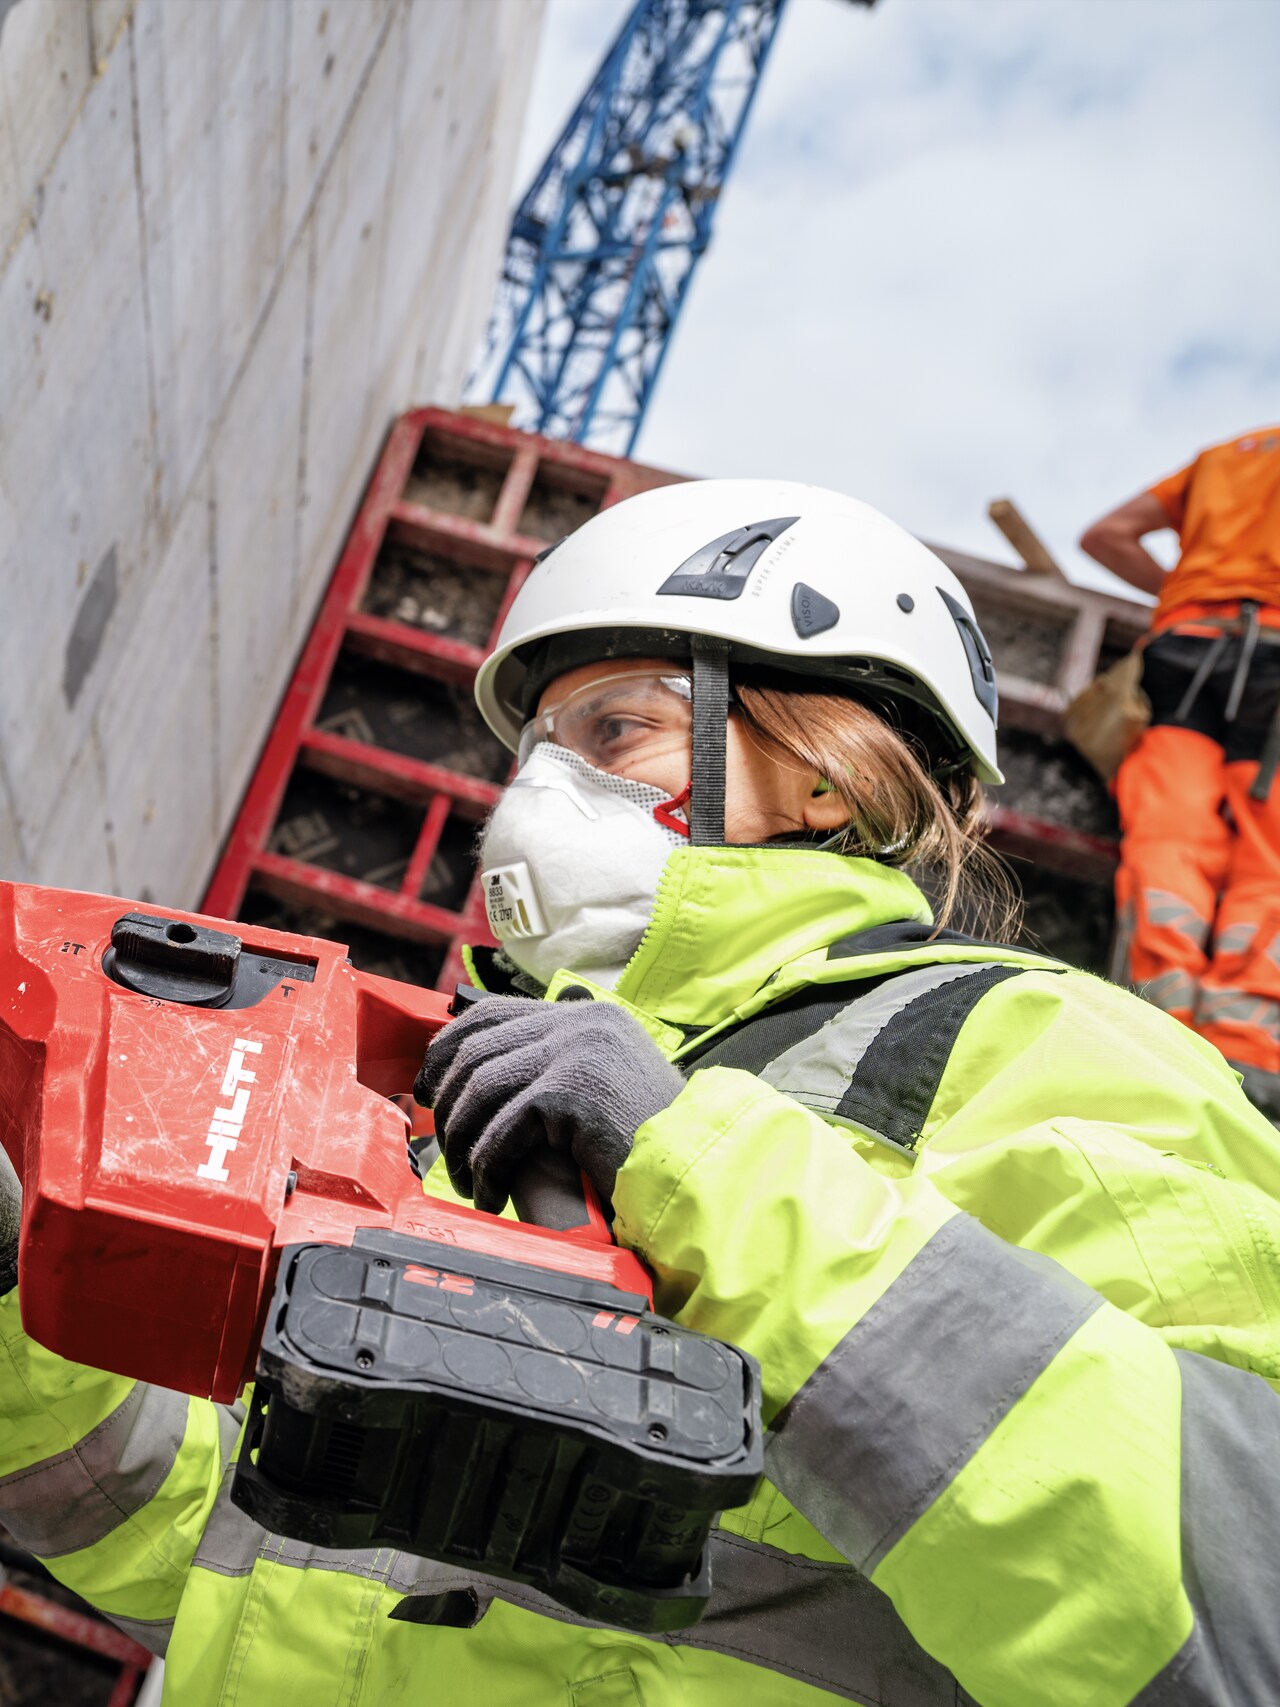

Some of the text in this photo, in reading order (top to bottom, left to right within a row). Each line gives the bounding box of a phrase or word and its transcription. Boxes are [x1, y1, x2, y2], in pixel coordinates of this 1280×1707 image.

[751, 536, 795, 597] SUPER PLASMA
[491, 875, 500, 886] 3M
[489, 886, 503, 897] 8833
[499, 908, 512, 921] 2797
[196, 1038, 263, 1182] HILTI
